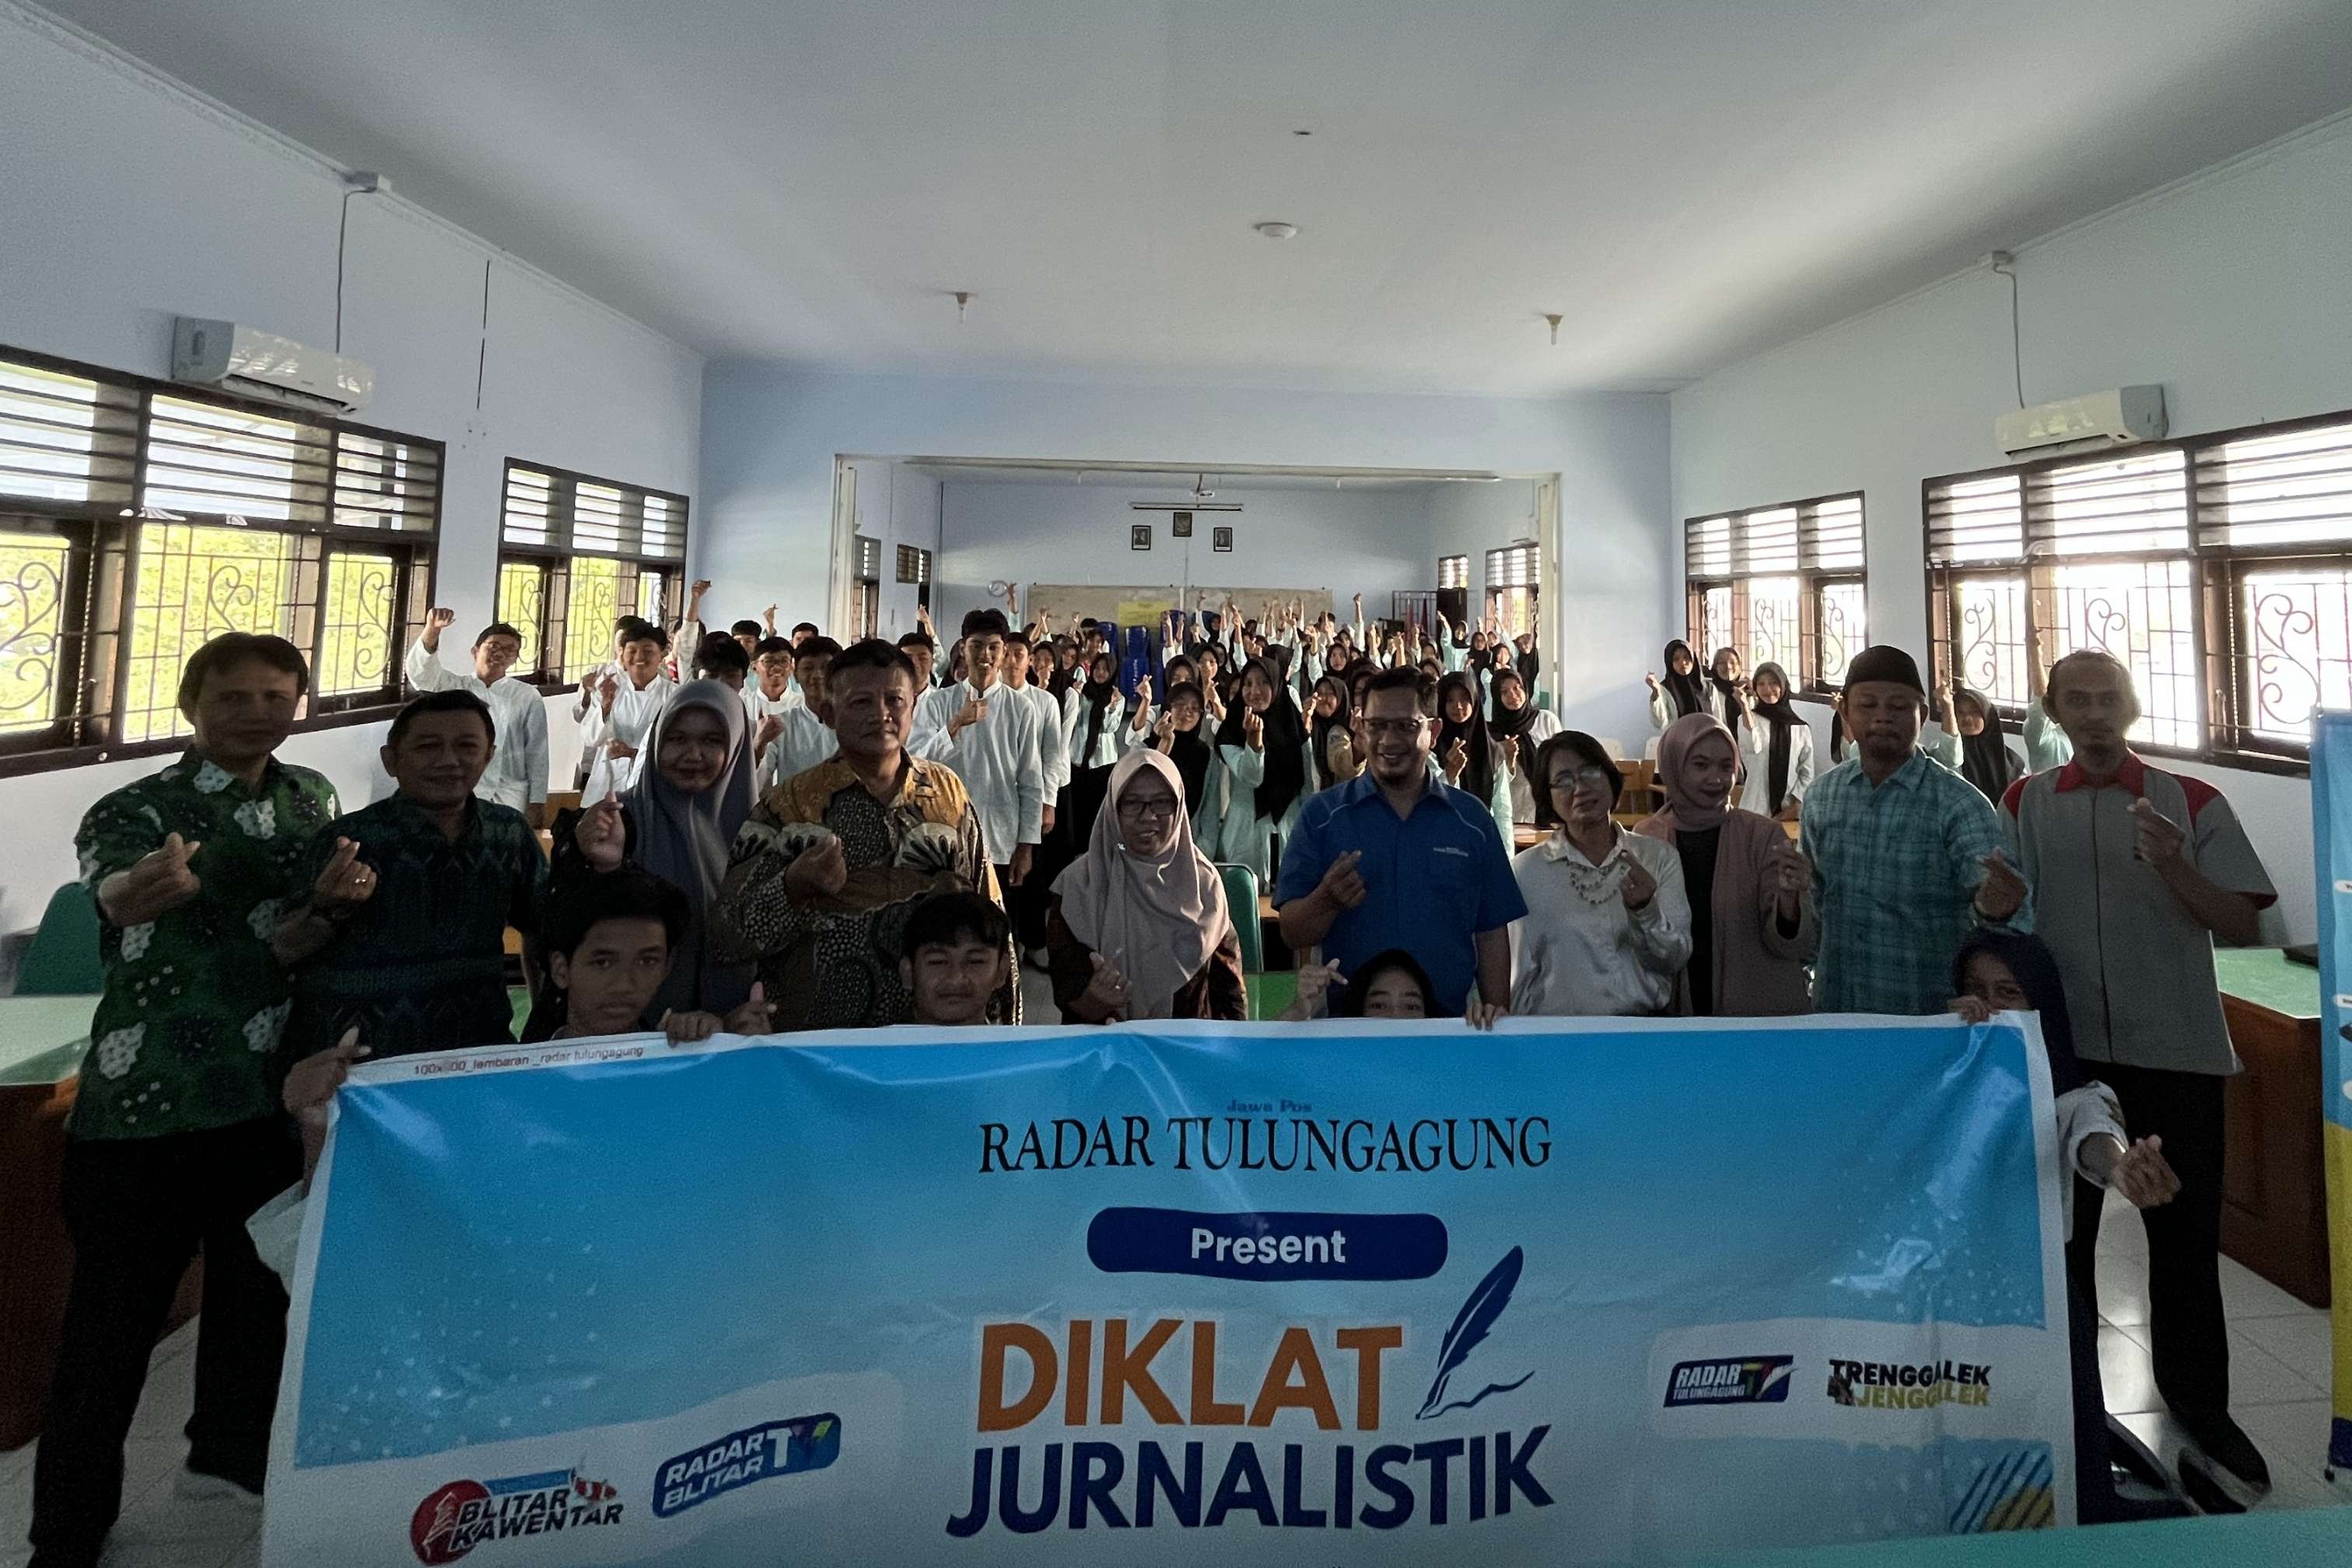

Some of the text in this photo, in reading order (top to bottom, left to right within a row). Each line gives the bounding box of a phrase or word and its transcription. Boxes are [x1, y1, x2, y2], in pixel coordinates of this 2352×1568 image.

[574, 1046, 644, 1062] tulungagung
[1226, 1098, 1314, 1112] Jawa Pos
[978, 1115, 1552, 1173] RADAR TULUNGAGUNG
[1191, 1227, 1346, 1264] Present
[977, 1318, 1402, 1432] DIKLAT
[1675, 1363, 1741, 1388] RADAR
[1829, 1359, 1992, 1387] TRENGGALEK
[1673, 1384, 1745, 1400] TULUNGAGUNG
[664, 1433, 765, 1488] RADAR
[662, 1455, 765, 1511] BLITAR
[946, 1424, 1555, 1538] JURNALISTIK
[448, 1503, 625, 1546] KAWENTAR
[457, 1488, 570, 1525] BLITAR
